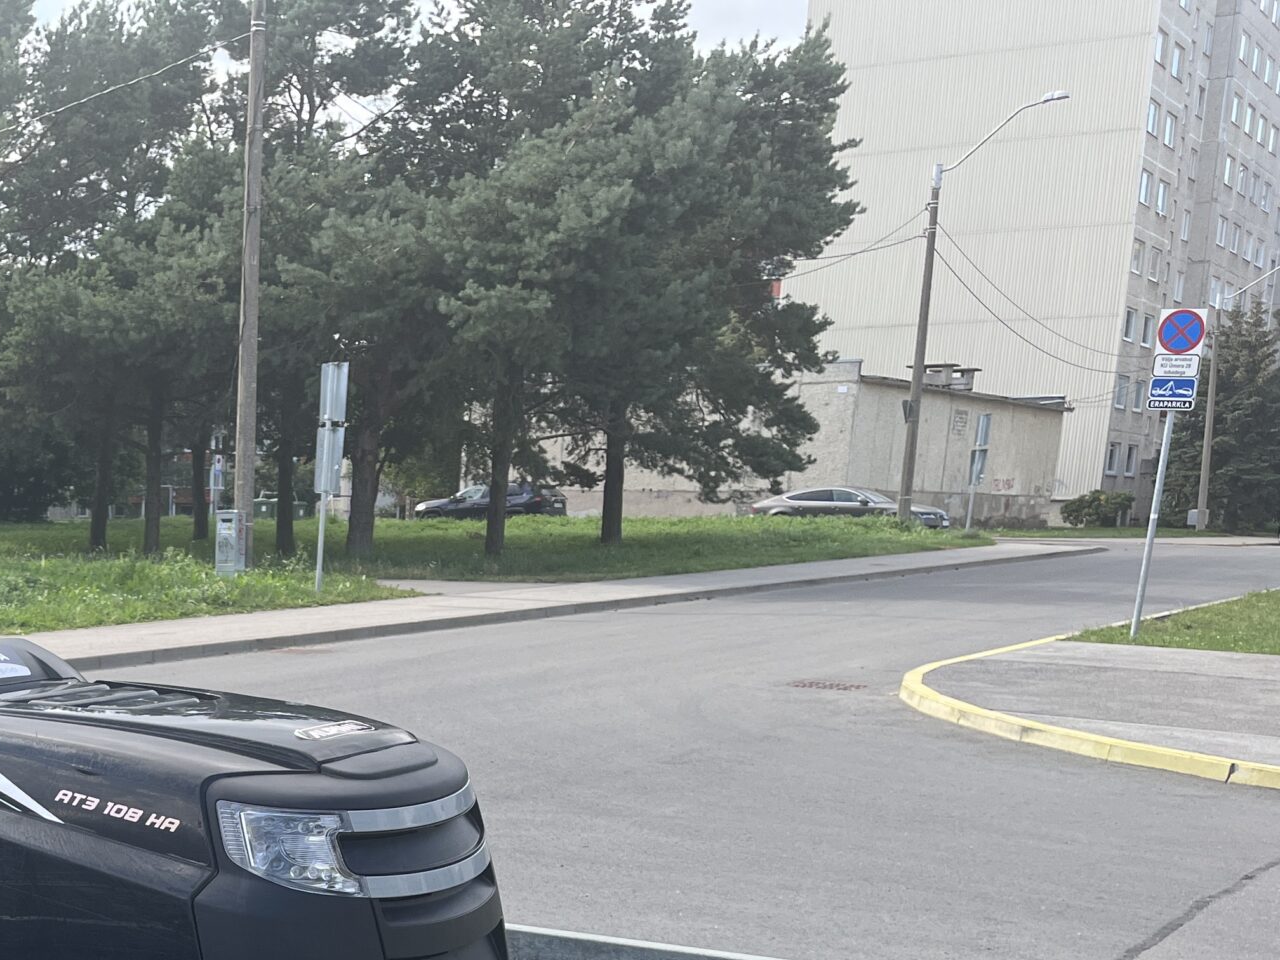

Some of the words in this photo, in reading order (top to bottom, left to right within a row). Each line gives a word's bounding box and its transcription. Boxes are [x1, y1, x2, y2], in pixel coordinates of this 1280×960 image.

[1150, 400, 1190, 408] ERAPARKLA
[103, 801, 144, 823] 108
[145, 813, 180, 833] HA
